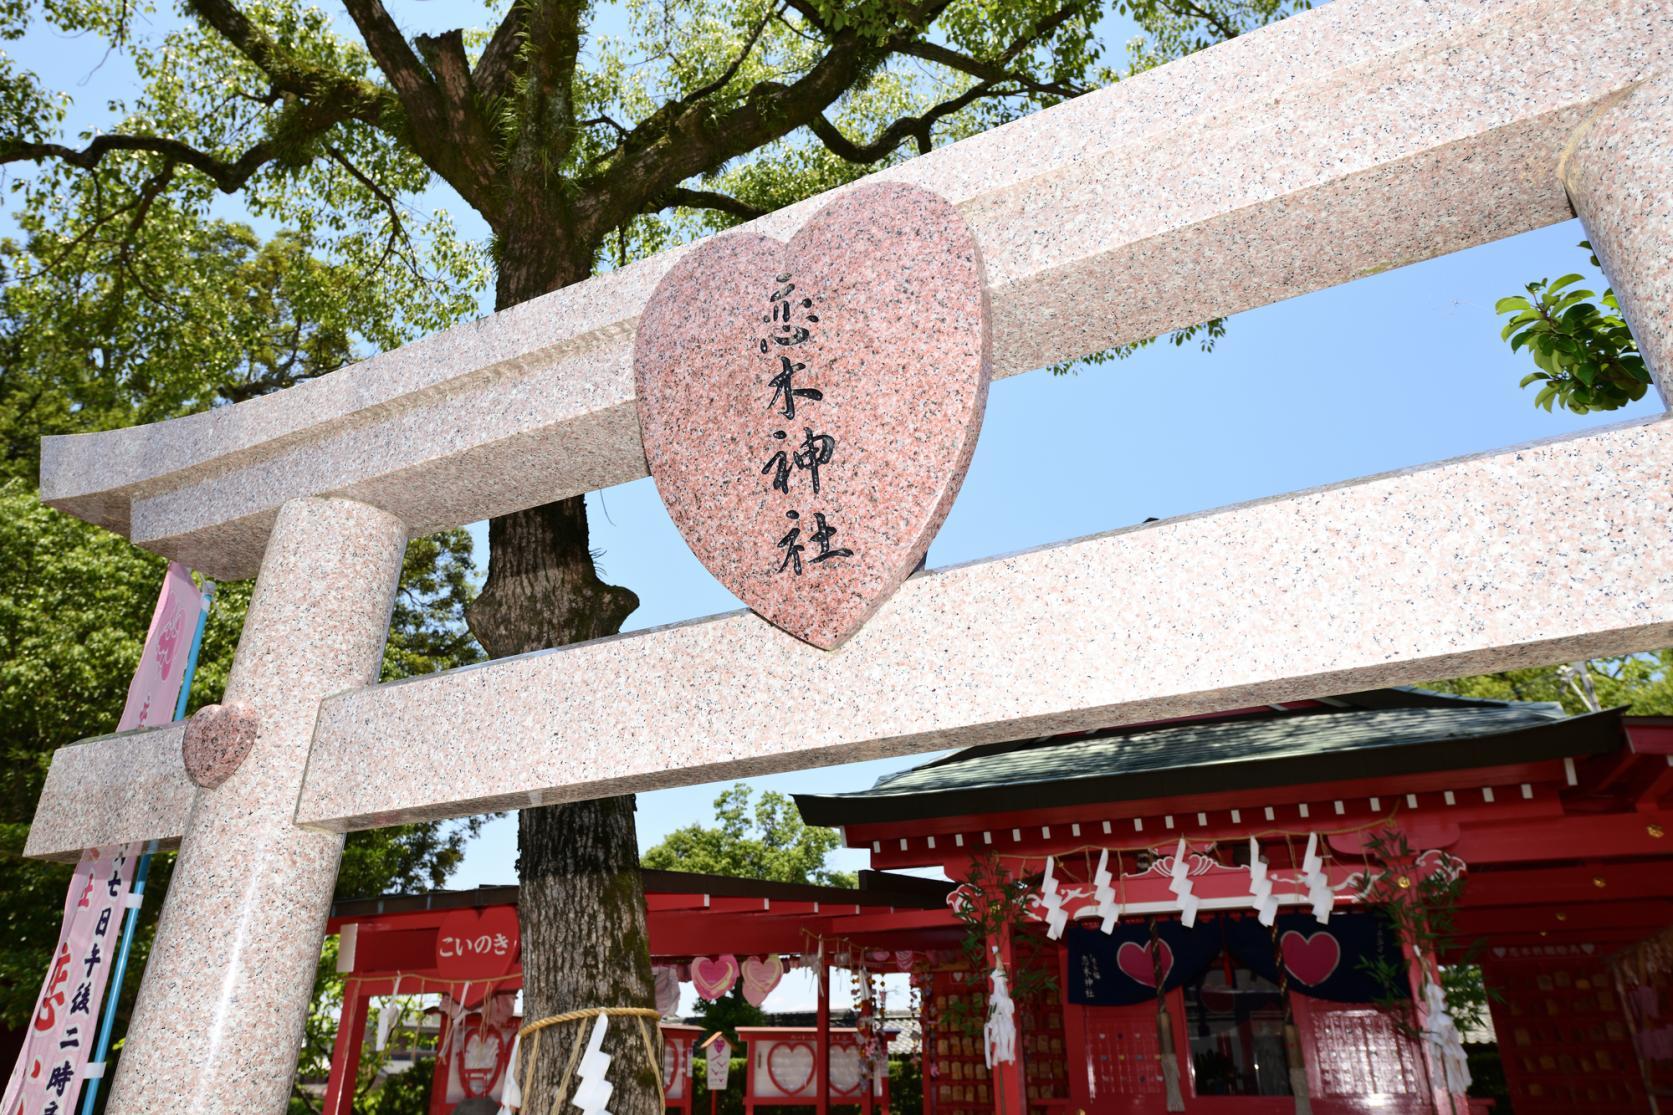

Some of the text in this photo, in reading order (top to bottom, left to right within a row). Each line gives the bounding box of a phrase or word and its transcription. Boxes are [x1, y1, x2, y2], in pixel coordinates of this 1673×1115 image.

[760, 272, 854, 576] 恋木神社
[440, 933, 517, 957] こいのき
